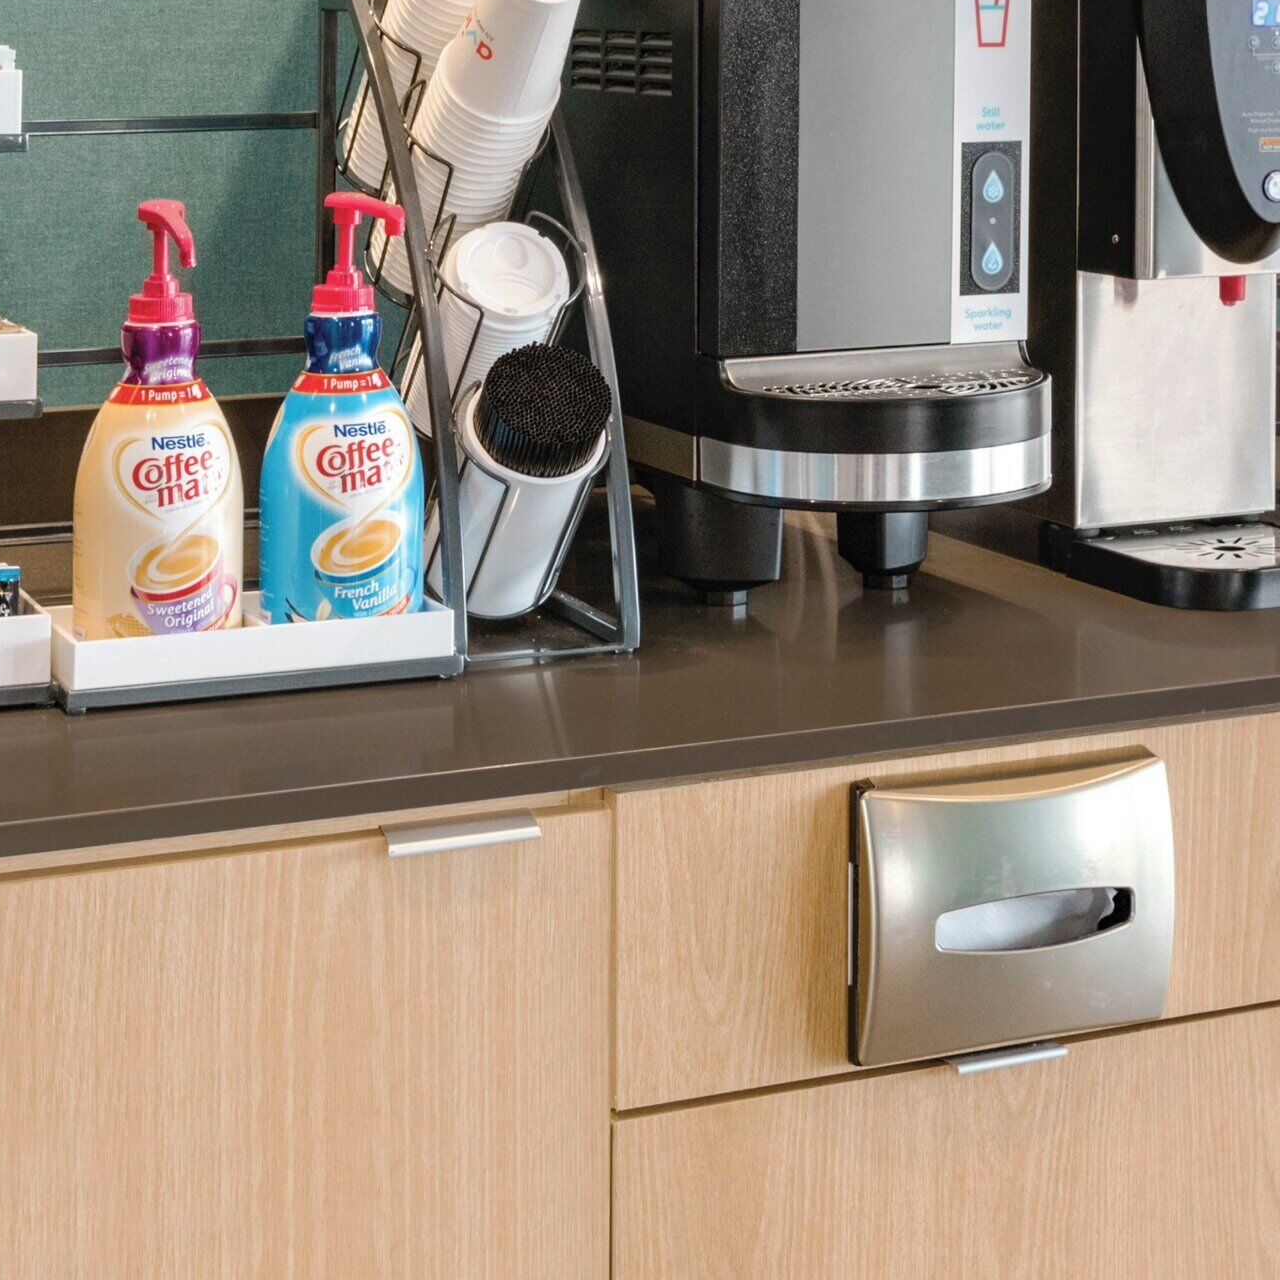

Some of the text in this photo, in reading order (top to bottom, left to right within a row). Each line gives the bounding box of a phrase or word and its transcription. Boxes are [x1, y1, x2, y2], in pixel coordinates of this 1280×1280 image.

[982, 106, 1000, 118] Still
[976, 121, 1005, 130] water
[963, 307, 1013, 320] Sparkling
[973, 321, 1003, 331] water
[323, 378, 329, 390] 1
[331, 377, 359, 391] Pump
[140, 390, 146, 401] 1
[148, 389, 178, 403] Pump
[334, 580, 380, 599] French
[146, 582, 214, 616] Sweetened
[352, 583, 398, 611] Vanilla
[164, 597, 215, 628] Original
